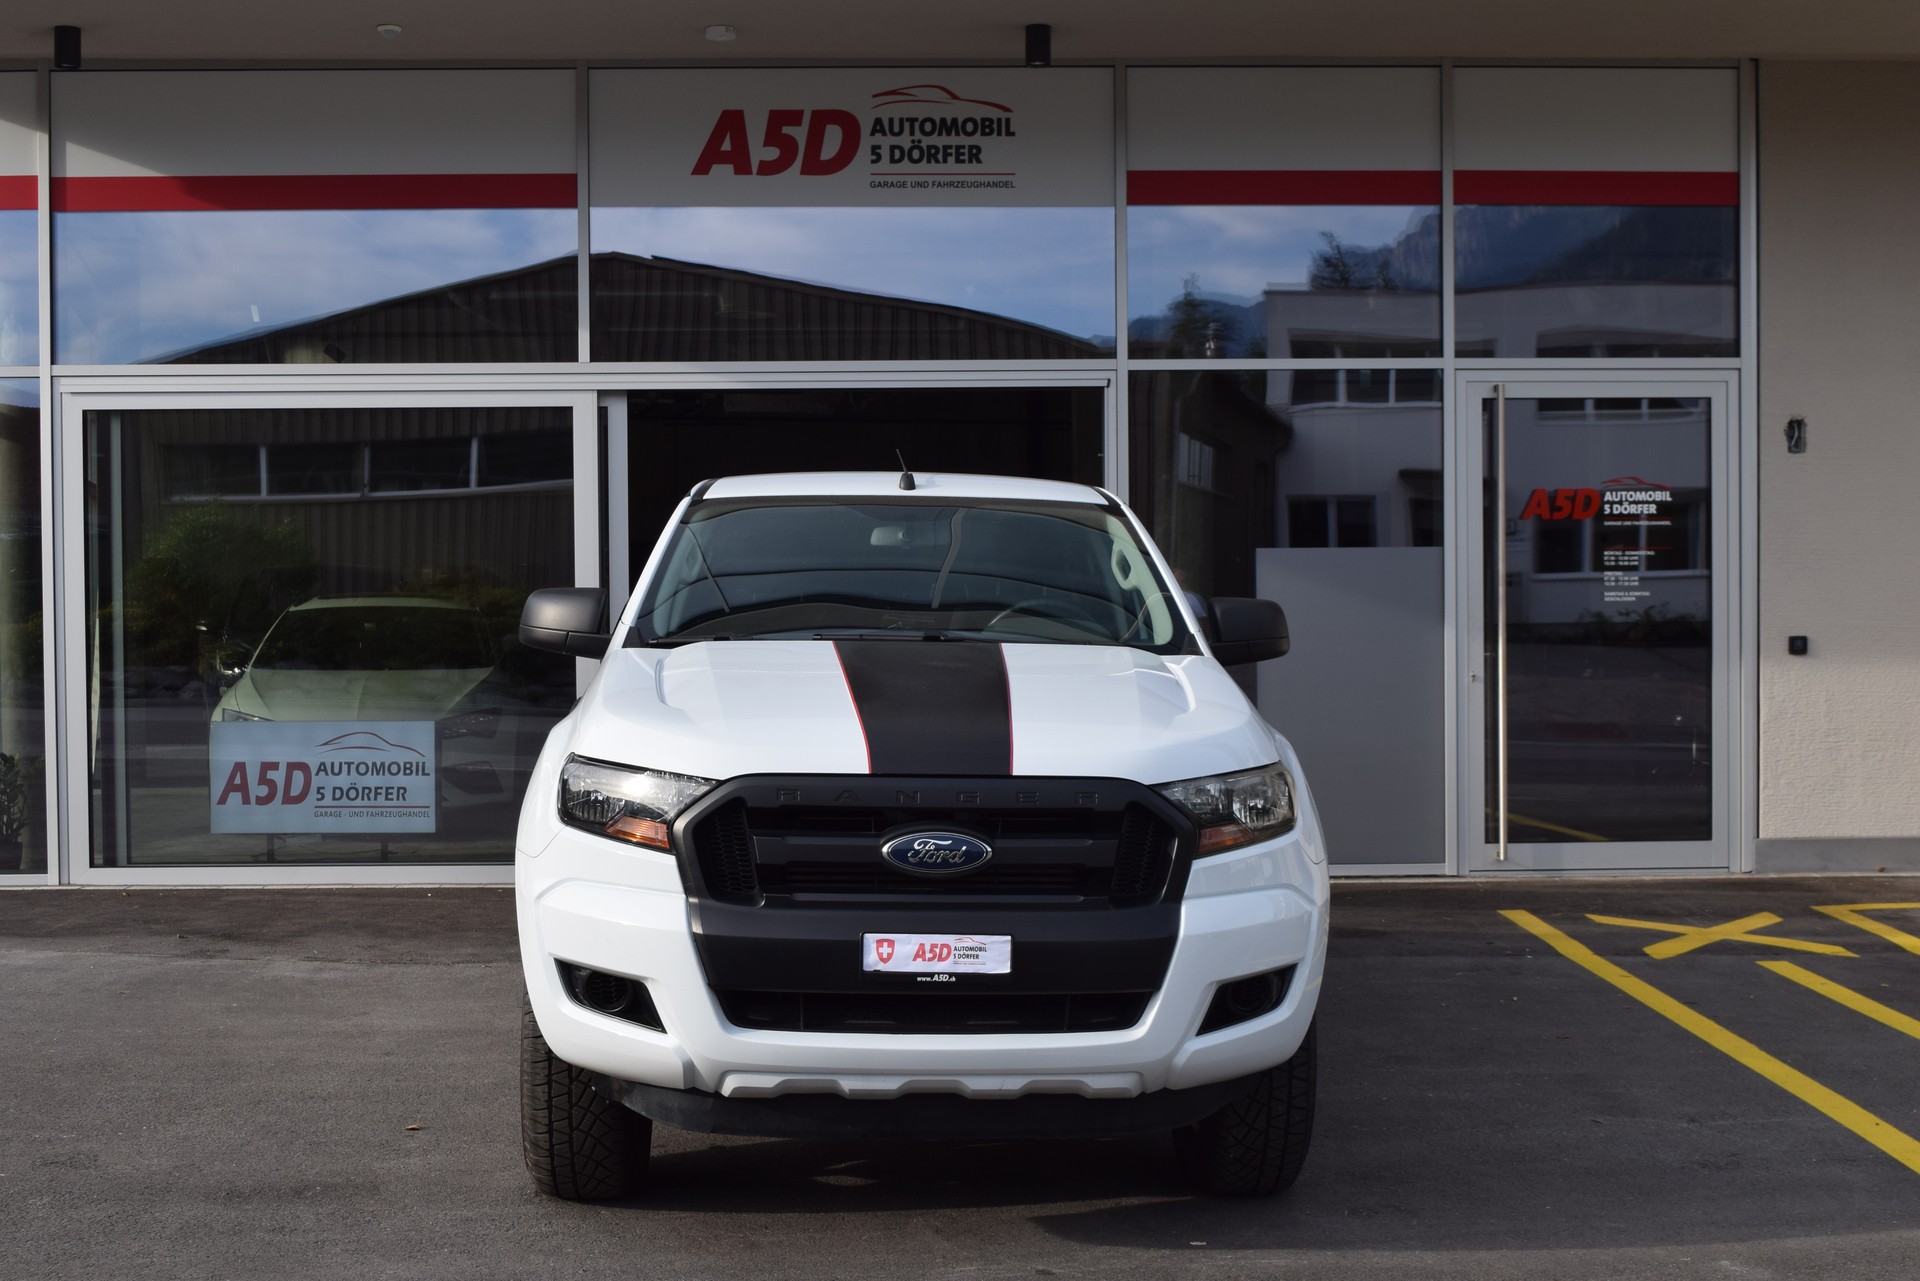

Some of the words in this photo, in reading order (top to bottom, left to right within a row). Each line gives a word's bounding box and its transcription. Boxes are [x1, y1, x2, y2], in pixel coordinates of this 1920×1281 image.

[869, 117, 1016, 137] AUTOMOBIL
[690, 109, 861, 176] A5D
[870, 144, 881, 164] 5
[890, 139, 983, 164] DÖRFER
[869, 180, 908, 189] GARAGE
[910, 180, 930, 189] UND
[931, 180, 1016, 189] FAHRZEUGHANDEL
[1521, 487, 1601, 520] A5D
[1604, 491, 1672, 502] AUTOMOBIL
[1603, 504, 1611, 514] 5
[1613, 502, 1657, 514] DÖRFER
[315, 761, 430, 777] AUTOMOBIL
[216, 761, 313, 806] A5D
[316, 786, 325, 801] 5
[332, 783, 407, 801] DÖRFER
[776, 788, 1098, 805] RANGER
[314, 810, 342, 818] GARAGE
[349, 810, 364, 818] UND
[366, 810, 430, 818] FAHRZEUGHANDEL
[907, 838, 967, 864] Ford
[912, 943, 952, 962] A5D
